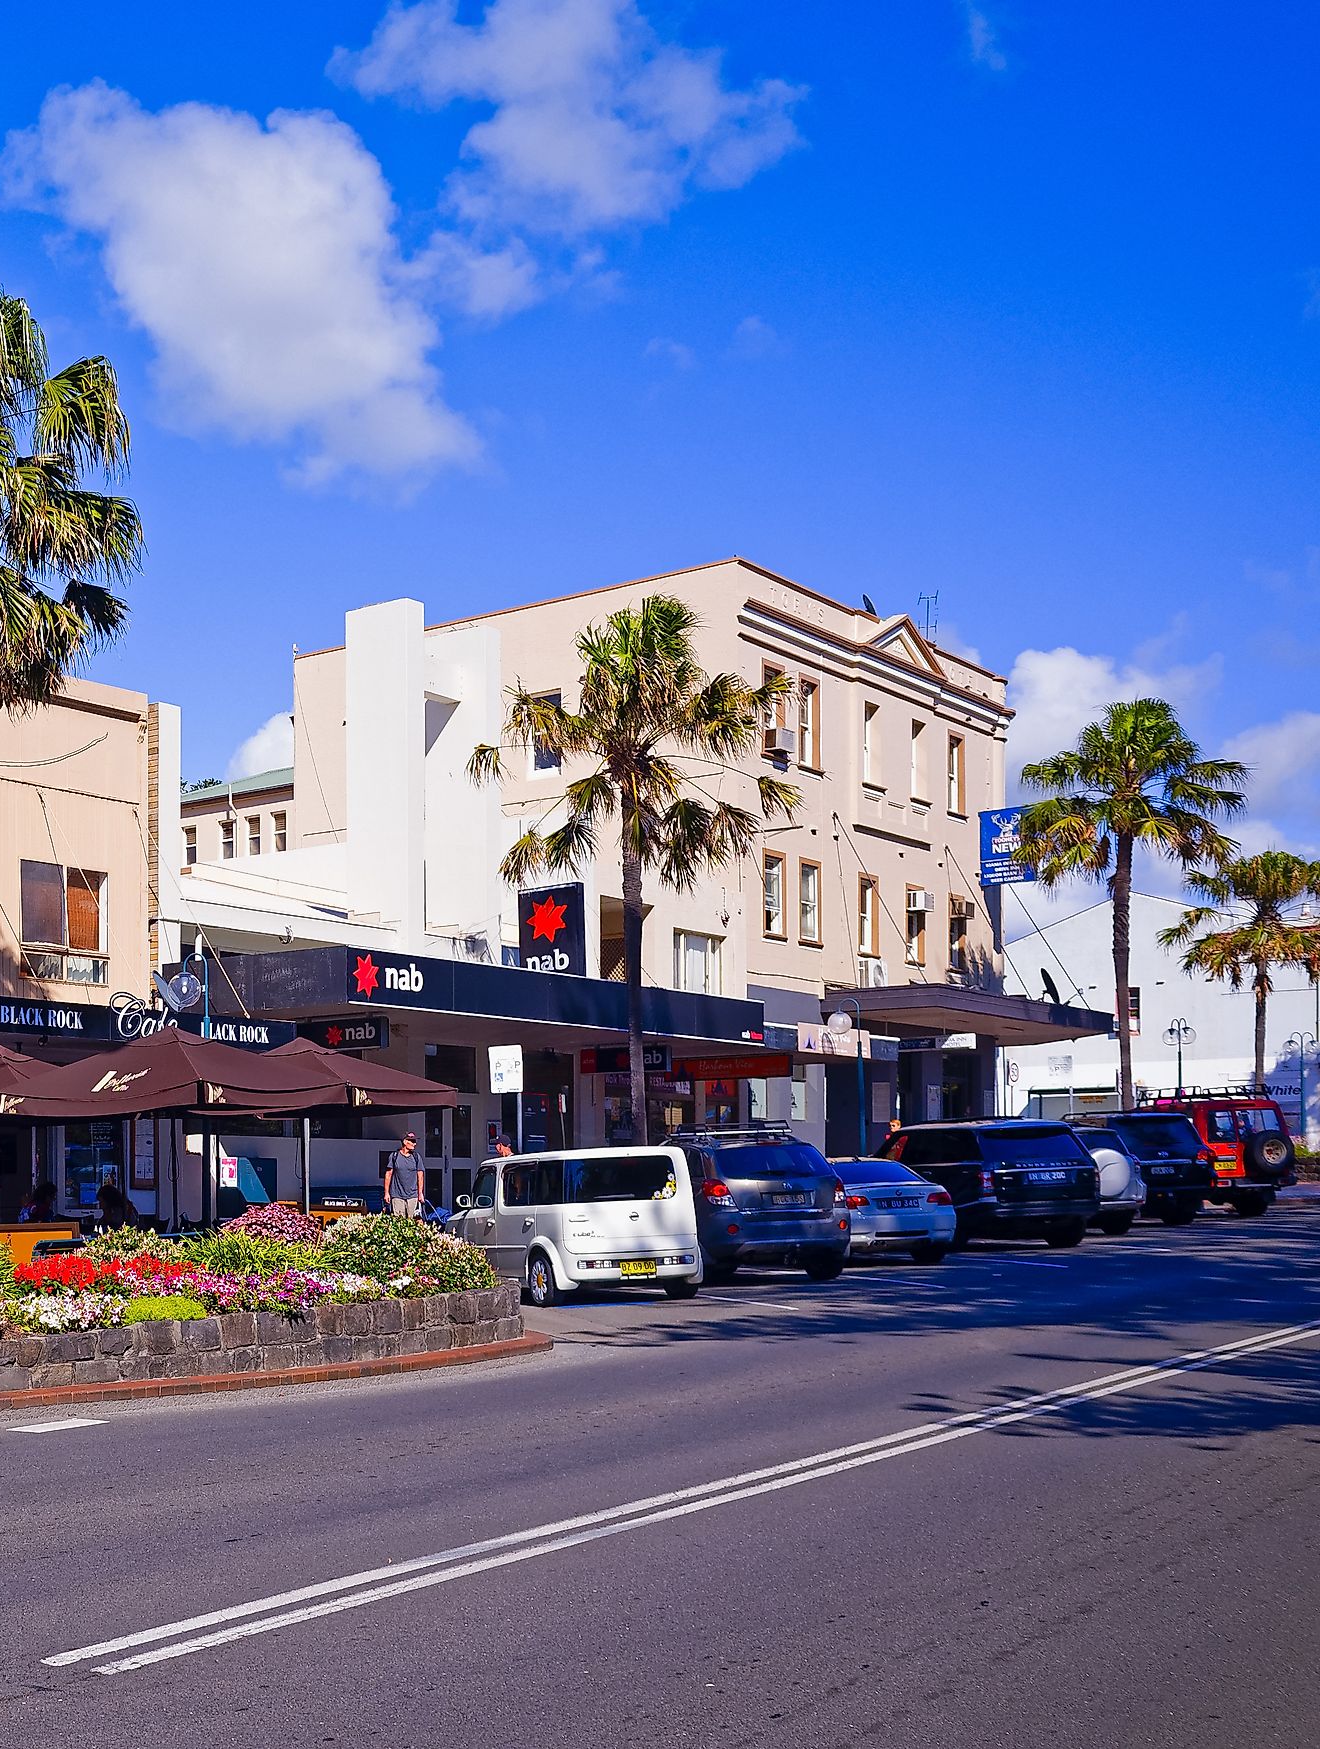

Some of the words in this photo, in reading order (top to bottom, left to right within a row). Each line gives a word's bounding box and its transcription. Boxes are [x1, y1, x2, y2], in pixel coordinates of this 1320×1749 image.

[992, 841, 1021, 854] NEW
[526, 948, 570, 971] nab
[384, 963, 424, 993] nab
[0, 1005, 44, 1027] BLACK
[48, 1008, 84, 1030] ROCK
[239, 1024, 270, 1044] ROCK
[345, 1022, 376, 1041] nab
[643, 1049, 663, 1065] ab
